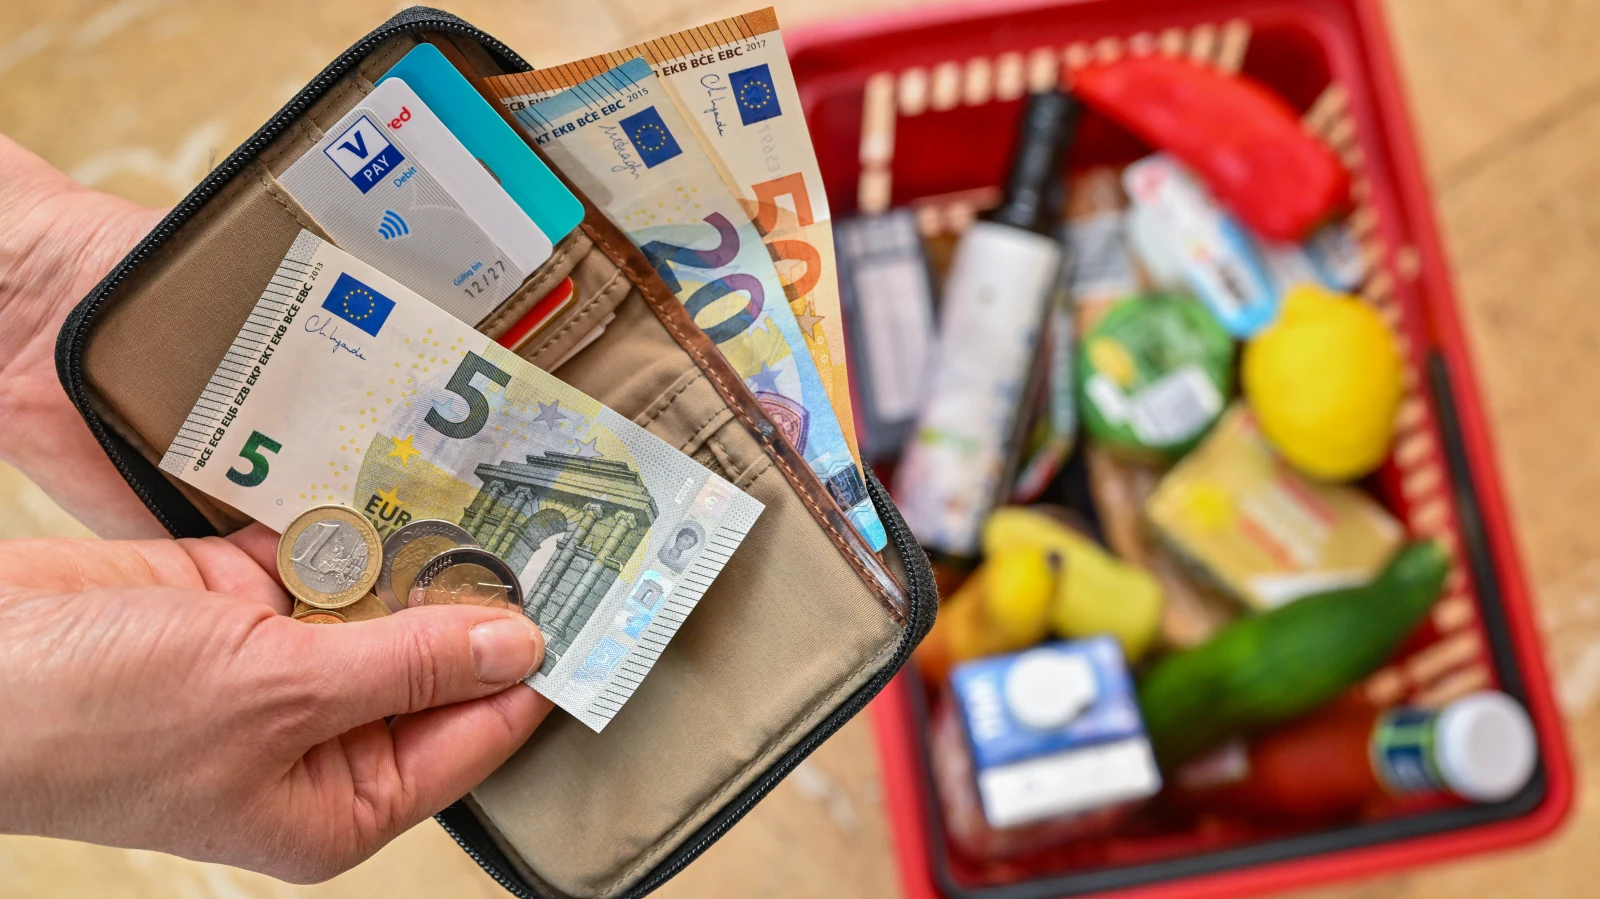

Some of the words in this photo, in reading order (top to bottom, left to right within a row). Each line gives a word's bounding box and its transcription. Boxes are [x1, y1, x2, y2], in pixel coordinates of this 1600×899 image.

[661, 62, 688, 77] EKB
[717, 46, 743, 61] EBC
[746, 39, 766, 52] 2017
[534, 132, 551, 146] KT
[552, 122, 576, 138] EKB
[601, 99, 626, 116] EBC
[627, 87, 649, 103] 2015
[336, 130, 369, 159] V
[363, 155, 389, 182] PAY
[393, 166, 417, 188] Debit
[751, 172, 821, 304] 50
[453, 269, 474, 287] Gültig
[471, 261, 483, 271] bis
[464, 260, 505, 298] 12/27
[639, 211, 765, 344] 20
[208, 427, 226, 448] ECB
[234, 386, 251, 407] EZB
[246, 365, 262, 387] EKP
[258, 345, 275, 366] EKT
[270, 324, 288, 346] EKB
[295, 282, 313, 304] EBC
[309, 262, 324, 281] 2013
[424, 350, 512, 439] 5
[225, 430, 282, 488] 5
[365, 494, 412, 527] EUR
[289, 522, 340, 571] 1
